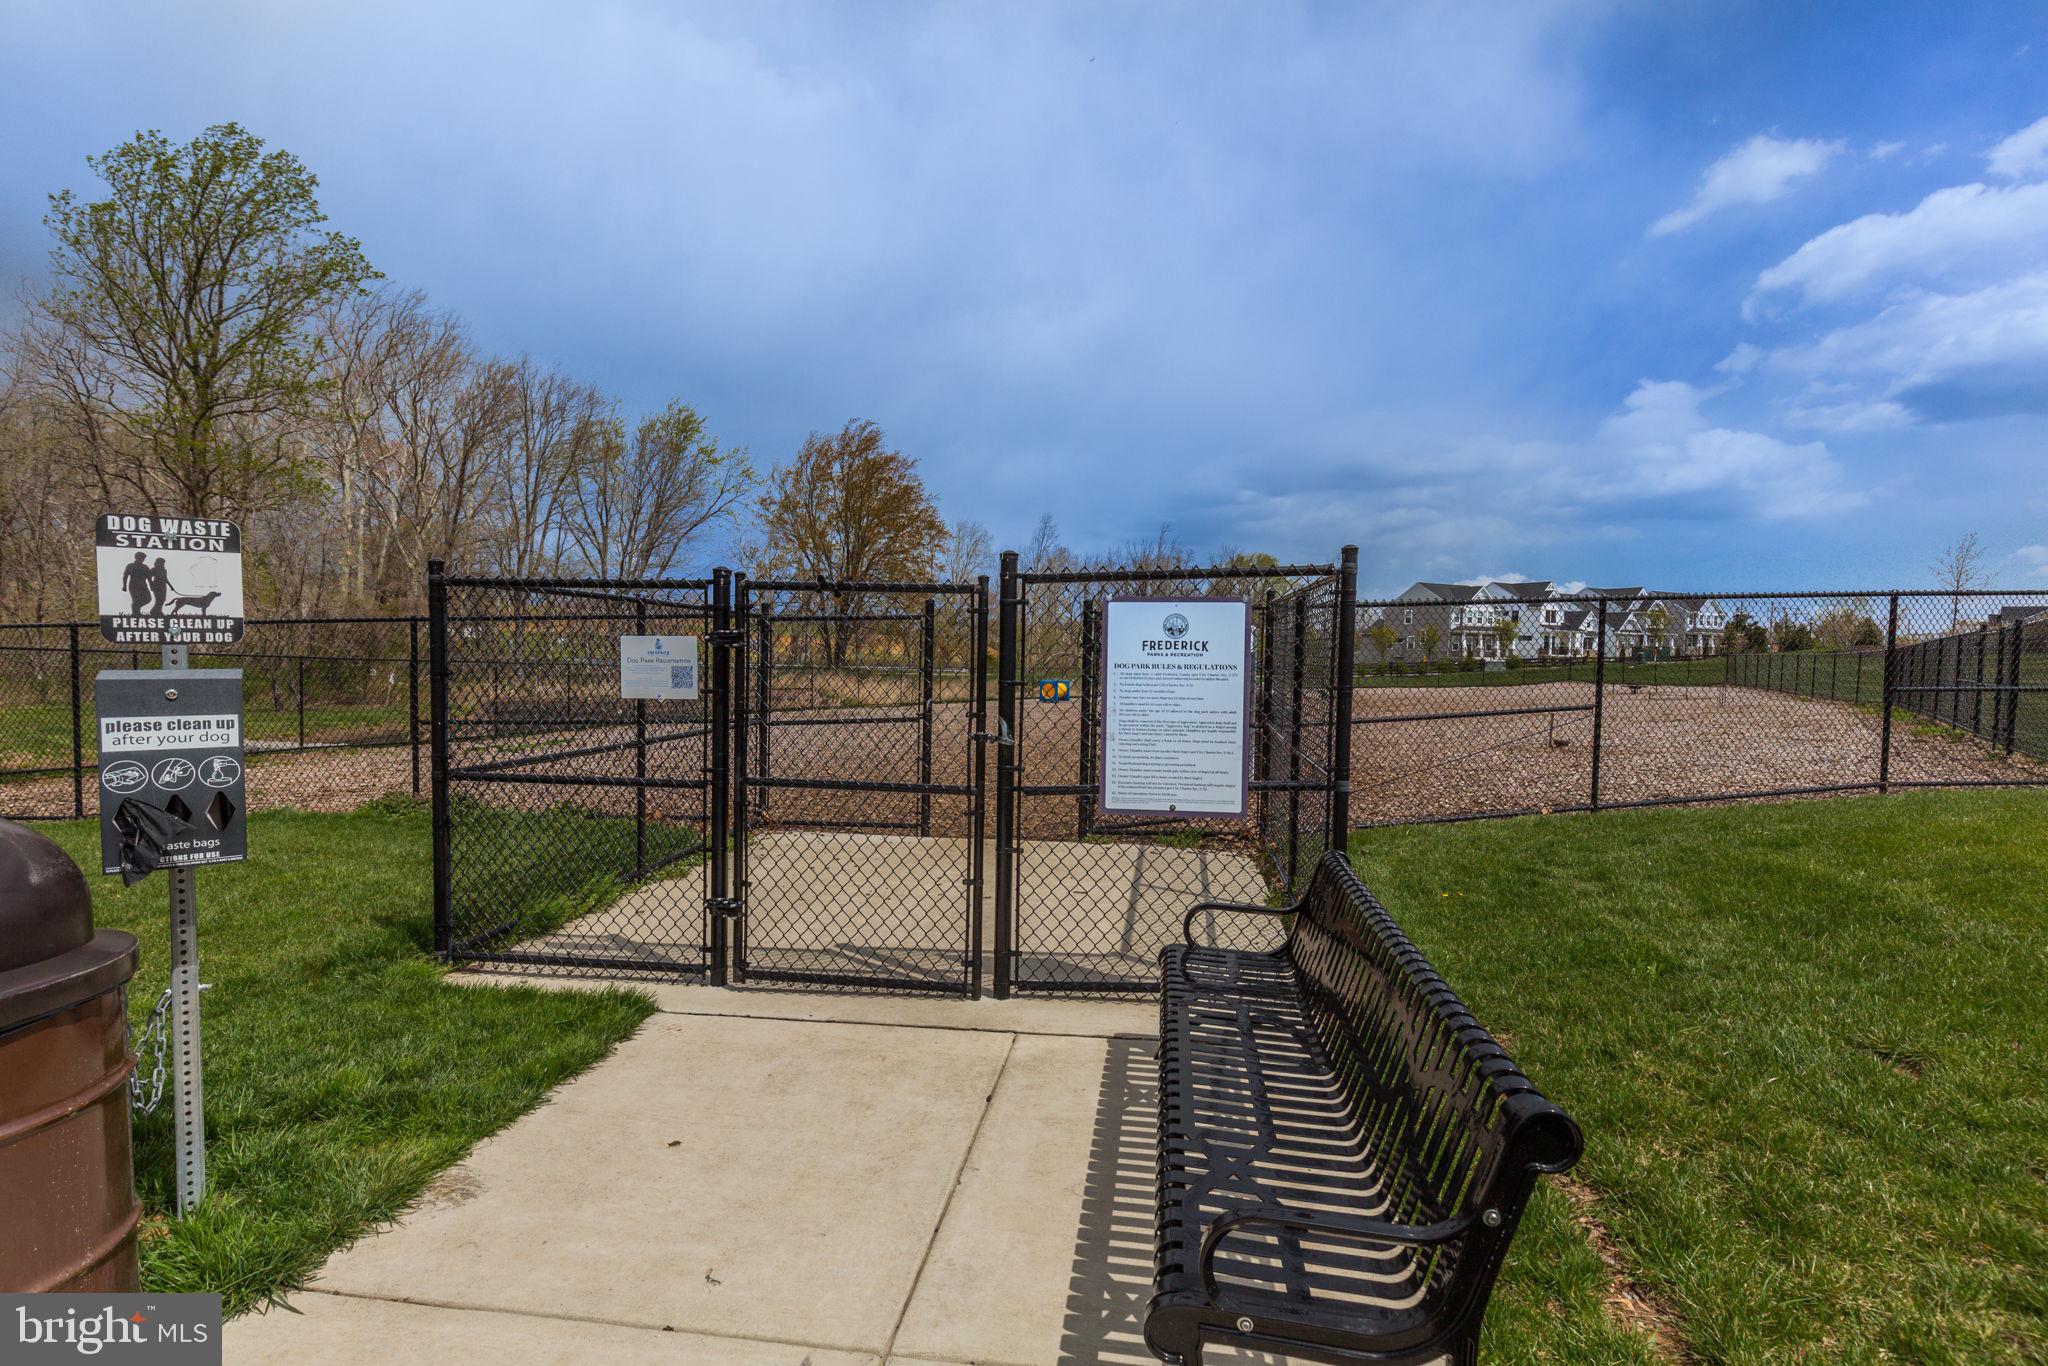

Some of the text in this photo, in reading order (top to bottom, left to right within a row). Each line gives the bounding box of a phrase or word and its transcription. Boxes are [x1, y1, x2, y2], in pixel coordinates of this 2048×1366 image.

[107, 515, 231, 537] DOG WASTE
[116, 534, 225, 552] STATION
[112, 617, 234, 630] PLEASE CLEAN UP
[116, 632, 233, 643] AFTER YOUR DOG
[1142, 640, 1209, 652] FREDERICK
[105, 718, 235, 735] please clean up
[112, 731, 230, 746] after your dog
[162, 838, 220, 850] aste bags
[160, 851, 220, 863] CTIONS FOR USE
